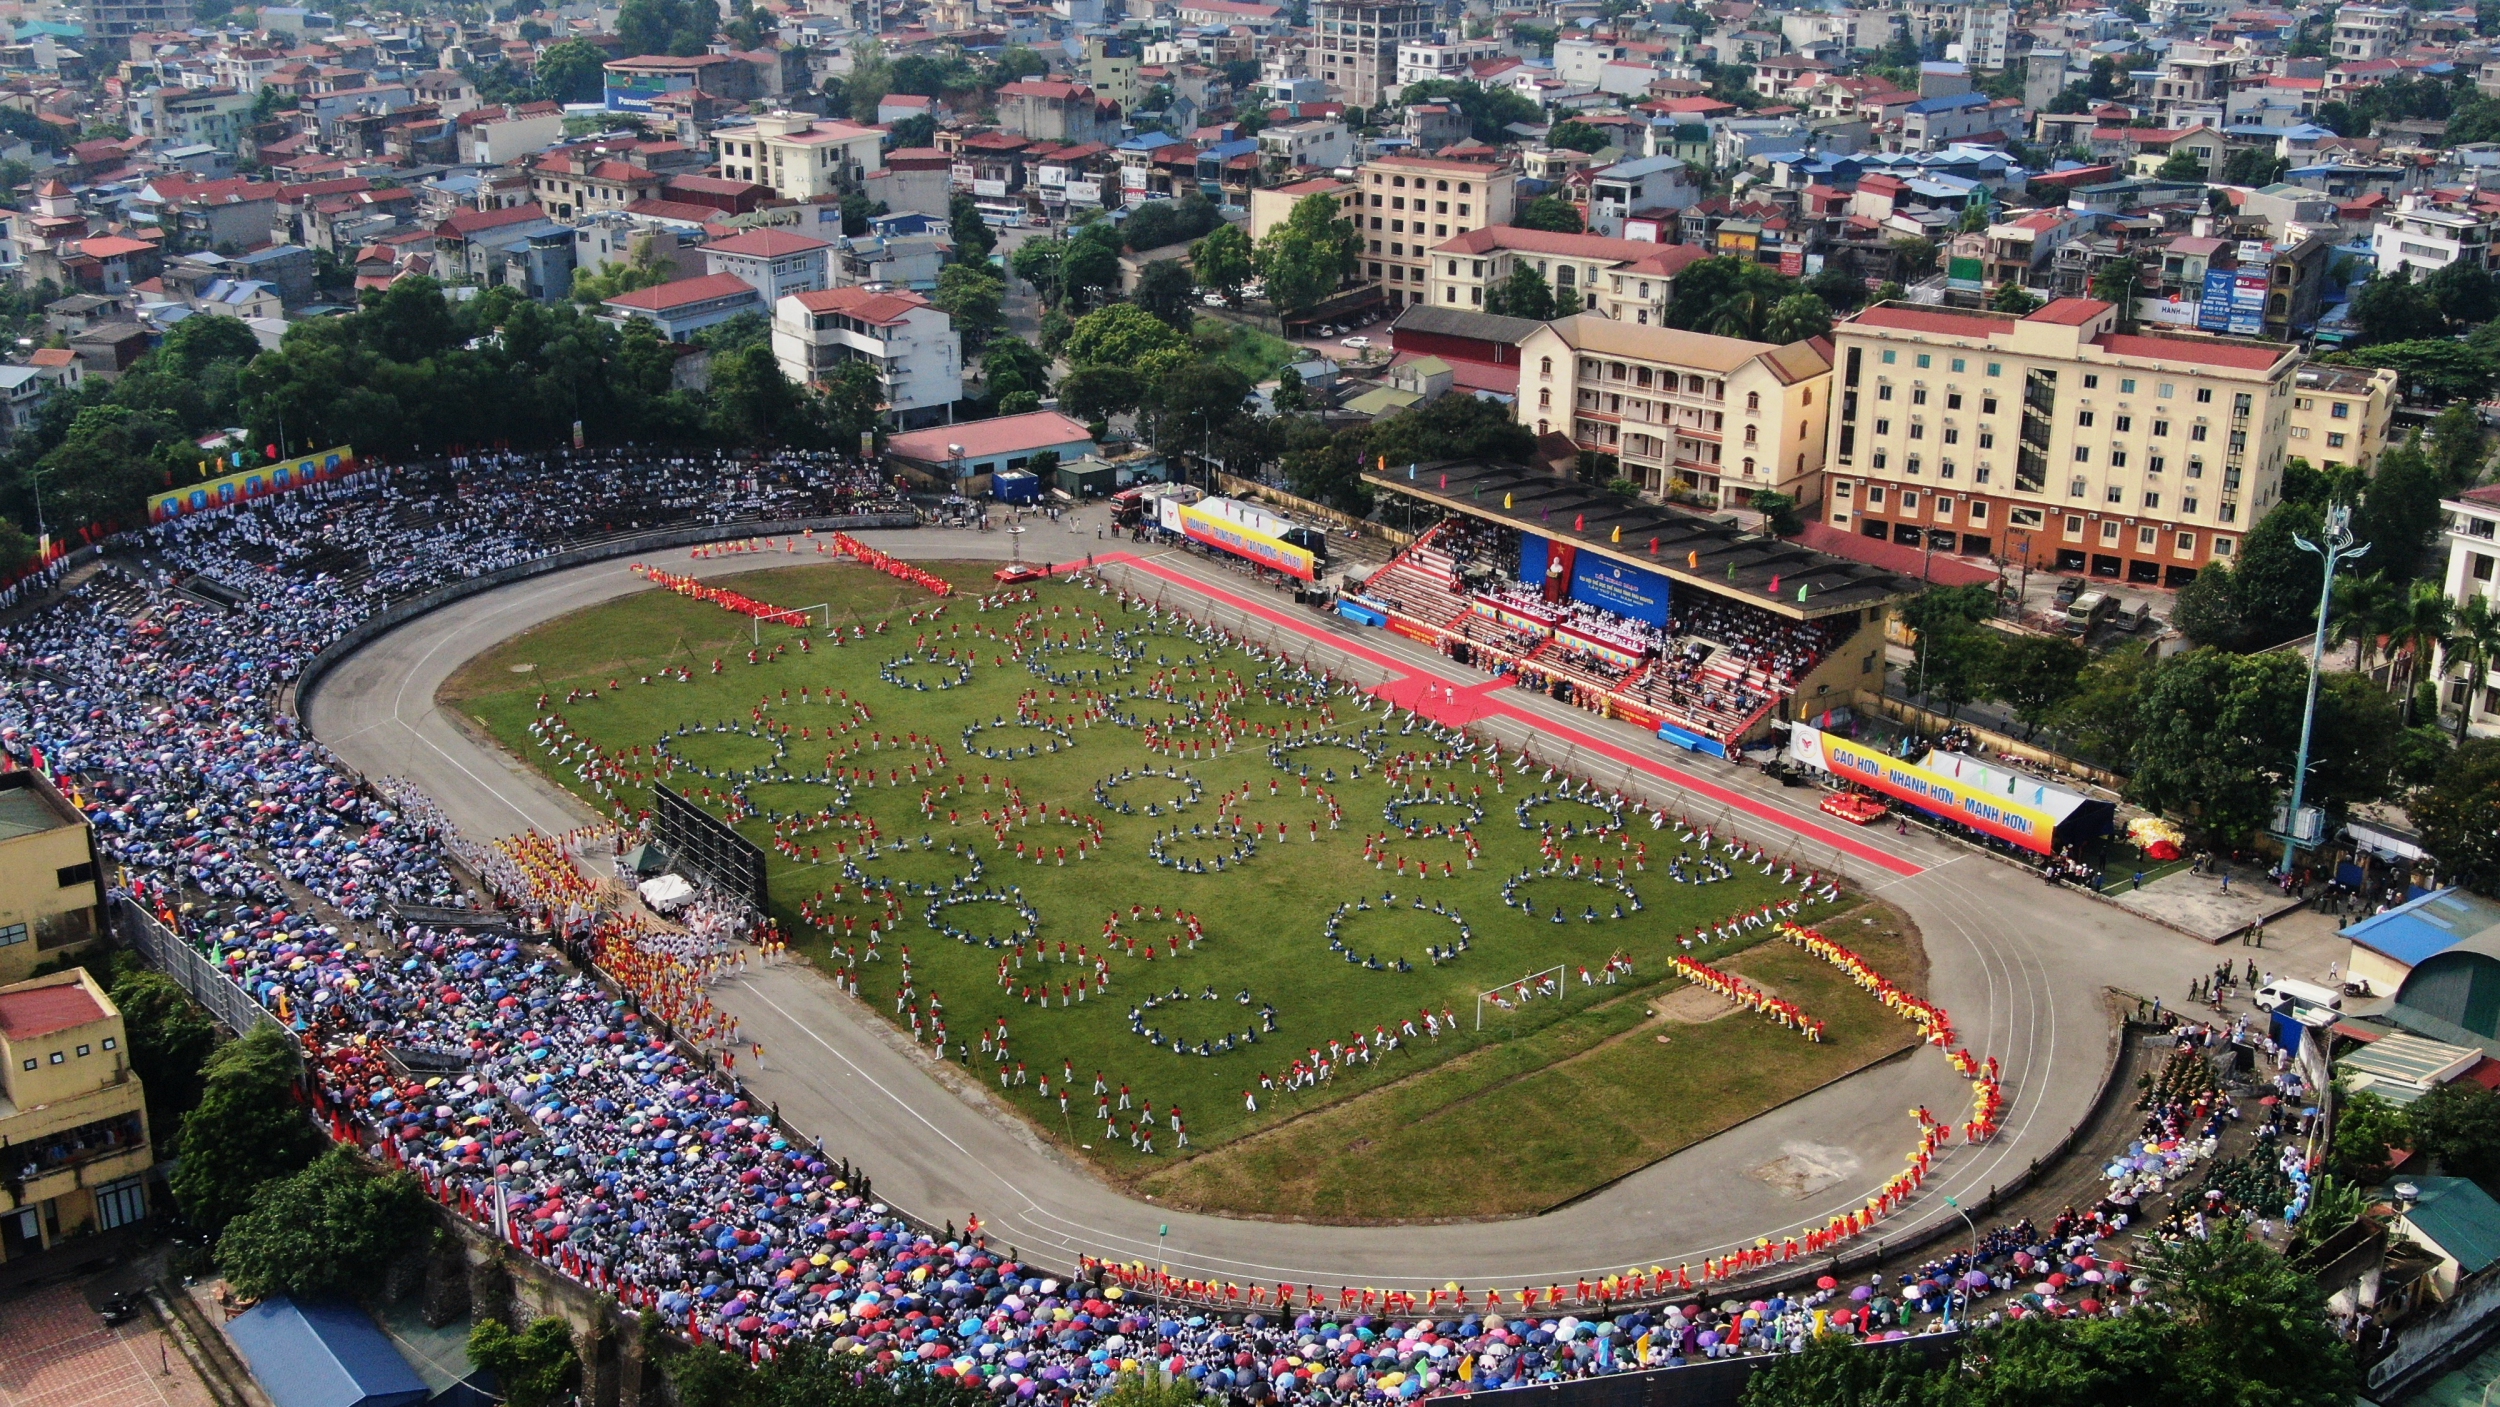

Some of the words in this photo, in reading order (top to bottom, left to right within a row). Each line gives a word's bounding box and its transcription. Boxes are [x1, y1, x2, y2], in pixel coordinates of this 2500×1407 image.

[1833, 748, 1854, 767] CAO
[1856, 756, 1879, 777] HƠN
[1889, 769, 1928, 795] NHANH
[1930, 784, 1954, 806] HƠN
[1964, 797, 1999, 821] MẠNH
